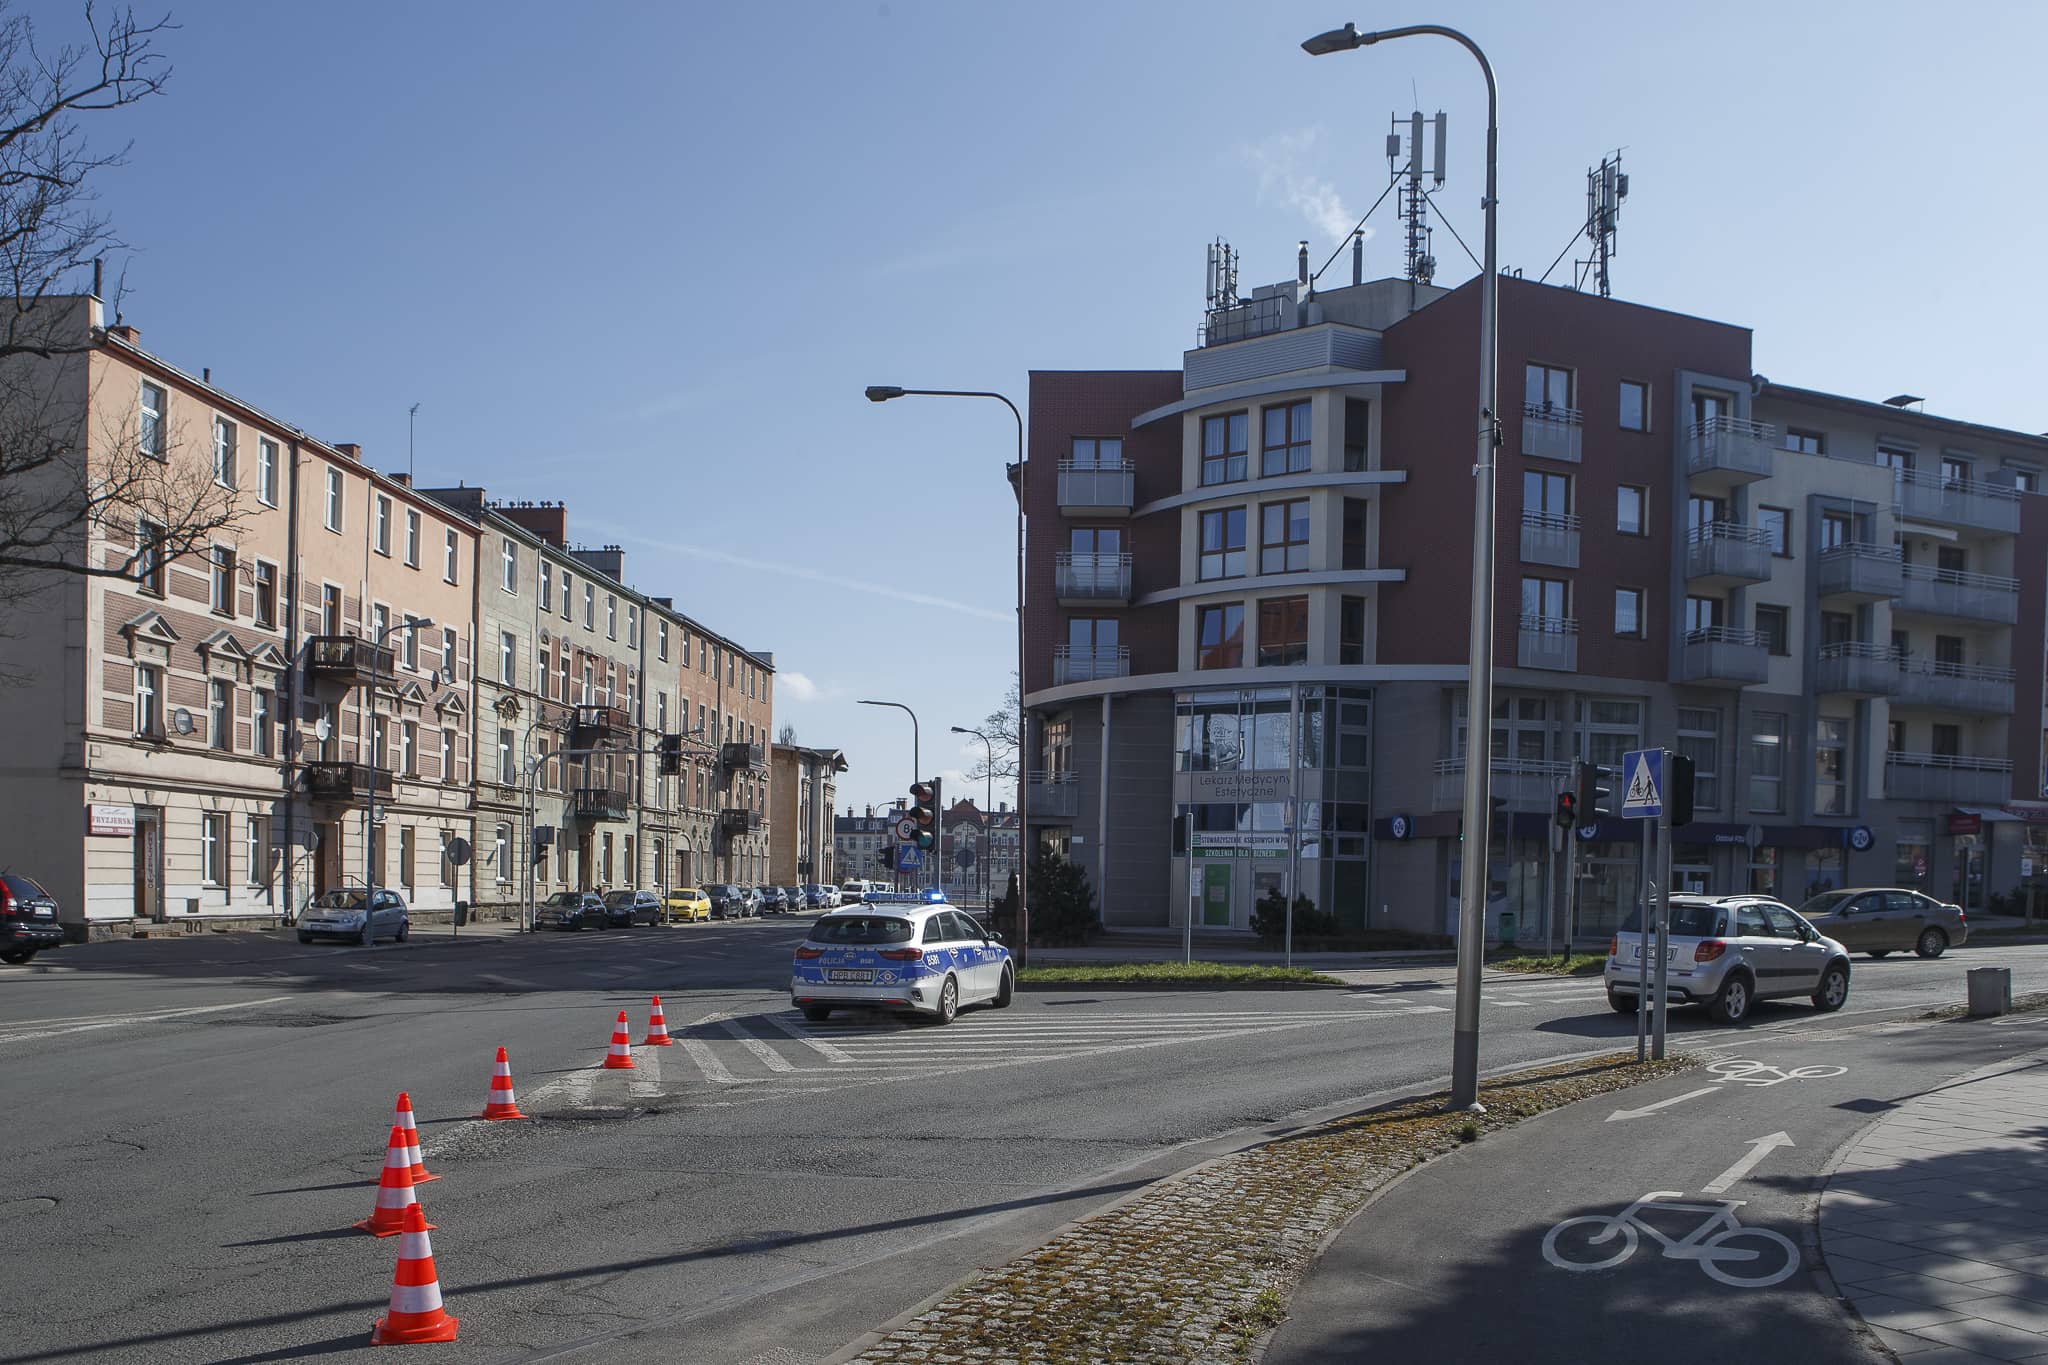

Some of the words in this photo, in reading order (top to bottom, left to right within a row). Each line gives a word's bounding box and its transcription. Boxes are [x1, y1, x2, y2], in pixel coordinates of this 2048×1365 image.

[1200, 775, 1232, 785] Lekarz
[1235, 774, 1290, 785] Medycyny
[1215, 787, 1277, 798] Estetycznej
[92, 815, 134, 825] FRYZJERSKI
[1205, 849, 1233, 857] SZKOLENIA
[818, 957, 845, 965] POLICJA
